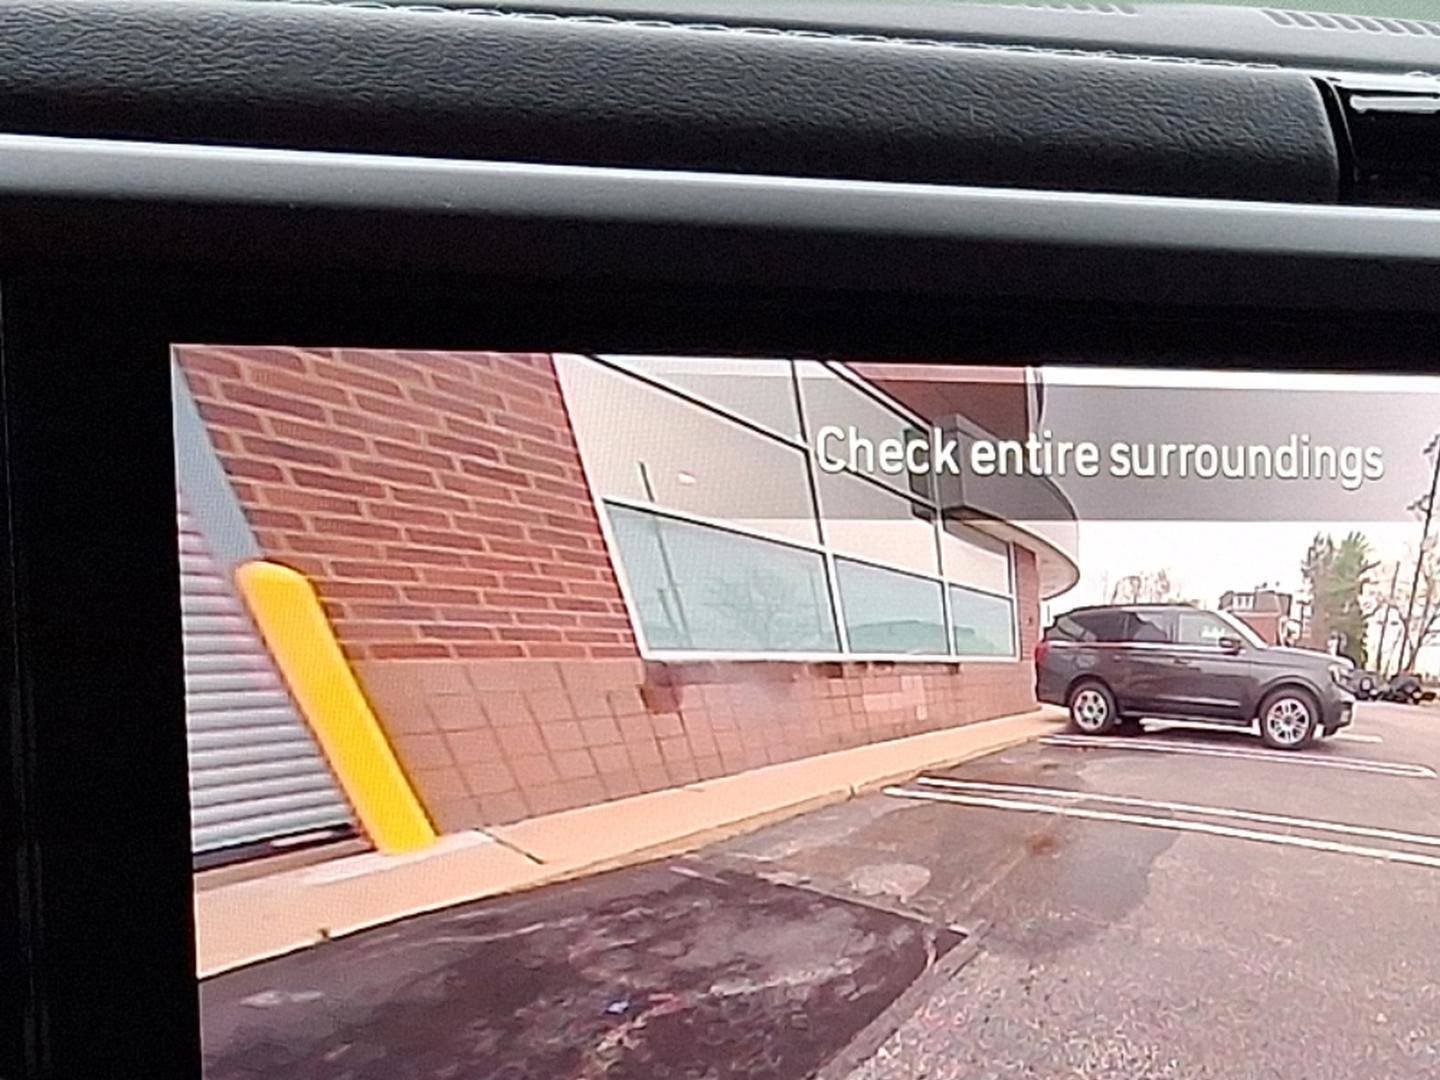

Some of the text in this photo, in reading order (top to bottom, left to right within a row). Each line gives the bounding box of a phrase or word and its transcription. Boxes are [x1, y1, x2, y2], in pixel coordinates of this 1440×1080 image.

[815, 425, 1384, 490] Check entire surroundings
